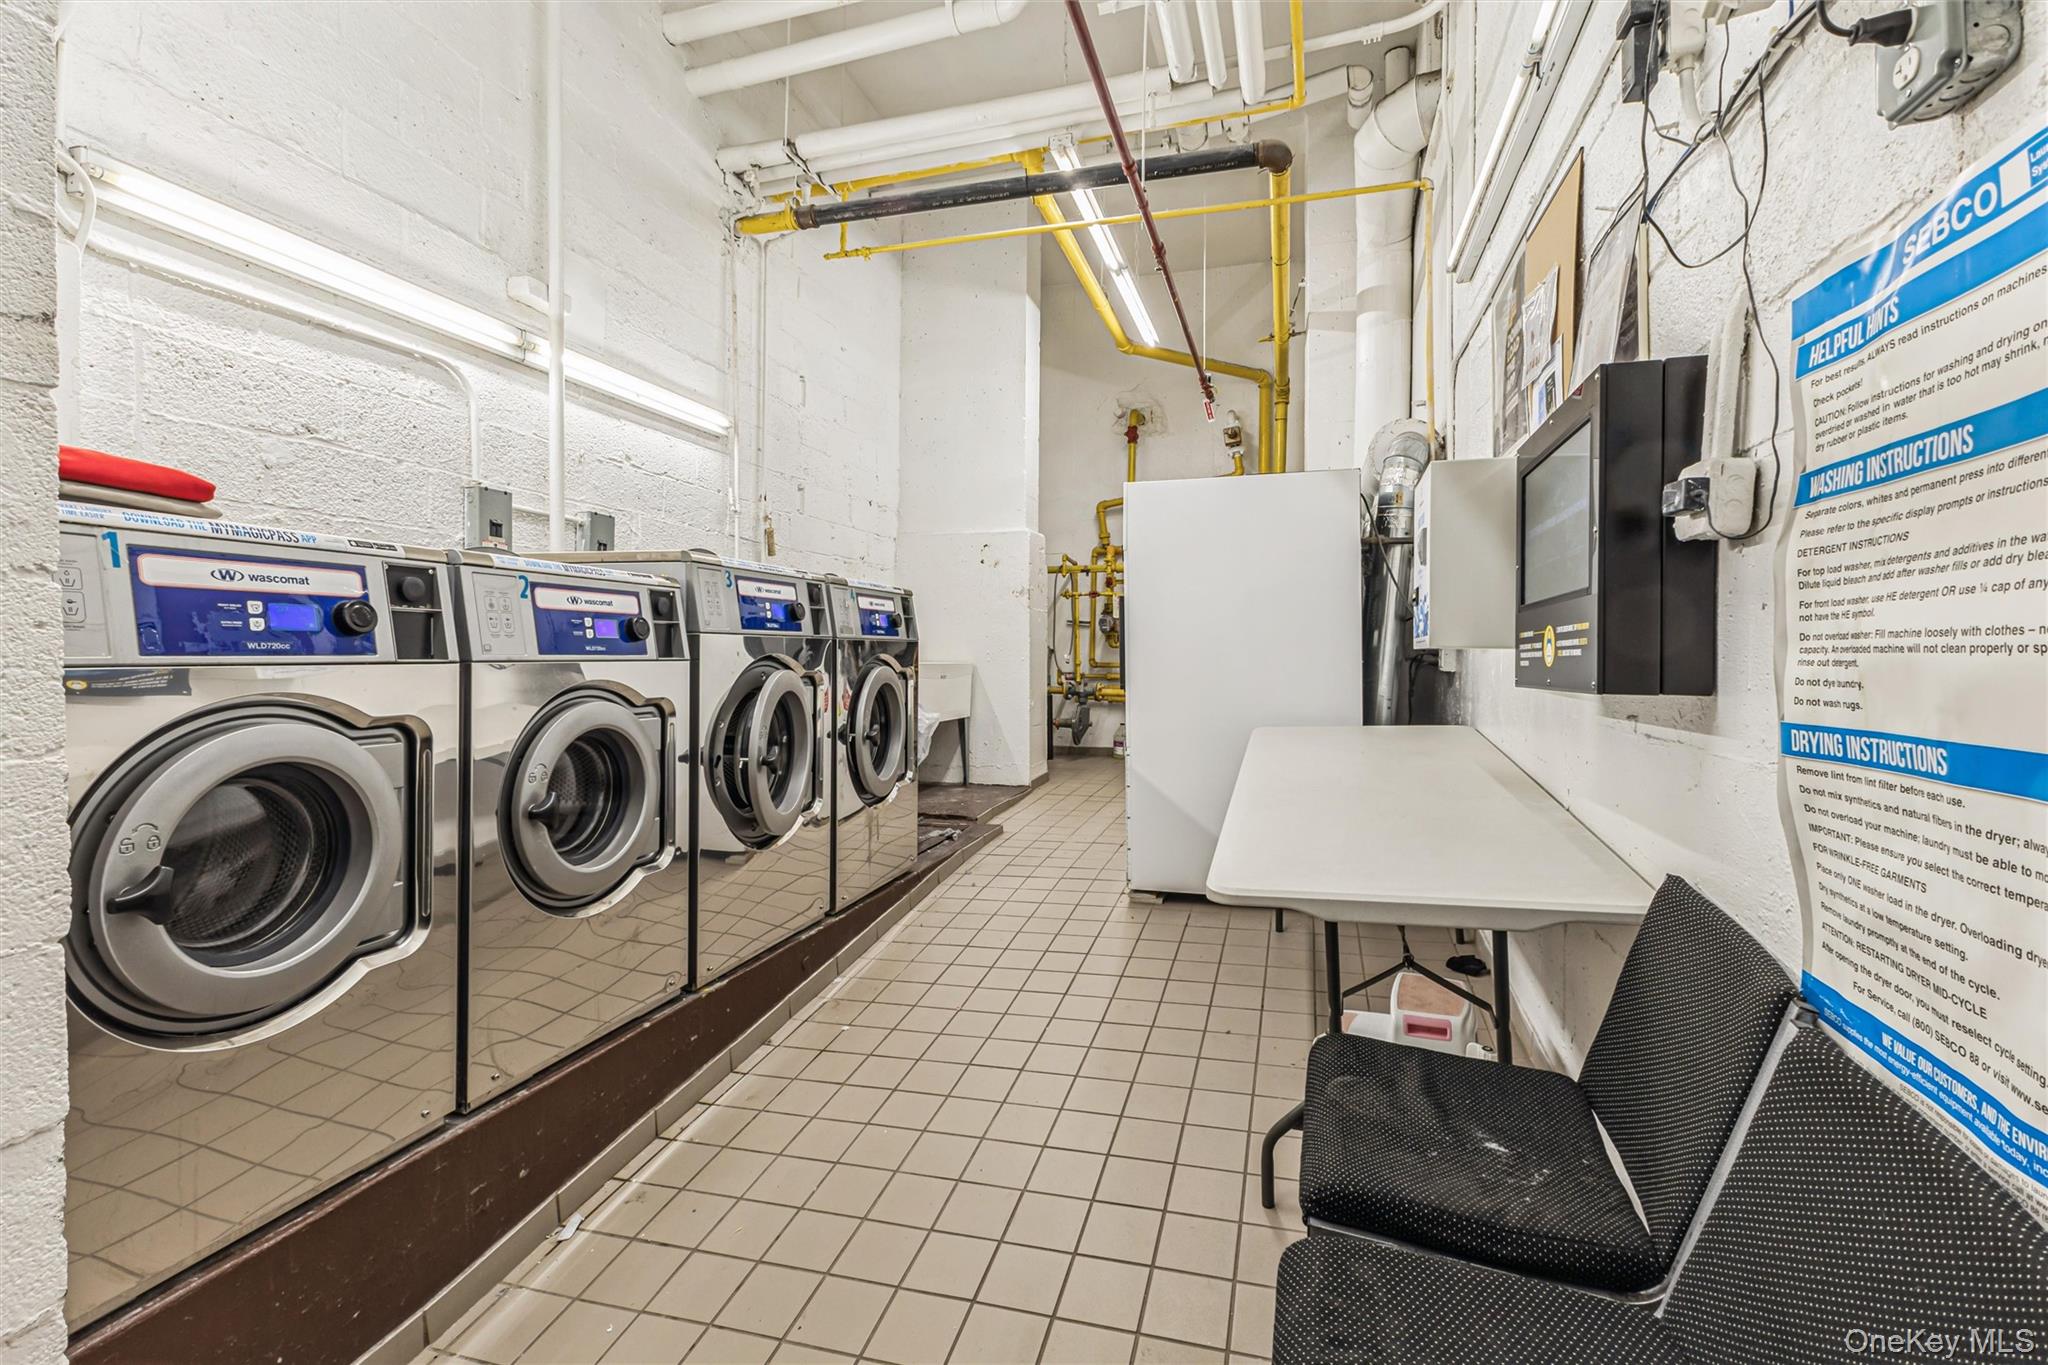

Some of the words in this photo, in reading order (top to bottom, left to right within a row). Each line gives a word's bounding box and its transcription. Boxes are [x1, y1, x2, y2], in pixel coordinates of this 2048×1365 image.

[1902, 181, 1998, 266] SEBCO
[1809, 322, 1865, 368] HELPFUL
[1866, 296, 1899, 340] HINTS
[1811, 379, 1823, 389] For
[1825, 370, 1841, 383] best
[1867, 339, 1896, 362] ALWAYS
[1897, 329, 1919, 347] read
[1921, 303, 1979, 335] instructions
[1981, 294, 1994, 307] on
[1997, 265, 2047, 297] machines
[1813, 393, 1834, 408] Check
[1836, 378, 1863, 400] pockets!
[1814, 408, 1845, 427] CAUTION:
[1848, 398, 1869, 413] Follow
[1871, 376, 1920, 403] instructions
[1923, 370, 1935, 382] for
[1937, 351, 1974, 377] washing
[1975, 341, 1993, 358] and
[1996, 329, 2030, 353] drying
[2033, 319, 2048, 333] on
[1815, 423, 1845, 440] overdried
[1846, 419, 1852, 427] or
[1854, 406, 1880, 423] washed
[1883, 402, 1890, 412] in
[1894, 393, 1917, 408] water
[1919, 384, 1935, 398] that
[1937, 379, 1944, 393] is
[1947, 373, 1962, 387] too
[1964, 367, 1980, 380] hot
[1981, 359, 2002, 376] may
[2004, 341, 2040, 363] shrink,
[1809, 472, 1864, 498] WASHING
[1866, 423, 1974, 482] INSTRUCTIONS
[1805, 506, 1837, 520] Separate
[1838, 499, 1864, 515] colors,
[1866, 494, 1893, 507] whites
[1895, 488, 1909, 500] and
[1910, 476, 1958, 498] permanent
[1959, 469, 1984, 485] press
[1987, 462, 2005, 475] into
[209, 522, 300, 544] MYMAGICPASS
[300, 533, 317, 544] APP
[1800, 524, 1825, 539] Please
[1826, 520, 1846, 535] refer
[1847, 518, 1855, 531] to
[1857, 515, 1870, 529] the
[1871, 511, 1904, 529] specific
[1905, 505, 1935, 522] display
[1937, 495, 1973, 515] prompts
[1975, 493, 1985, 503] or
[101, 530, 121, 568] 1
[1797, 542, 1847, 559] DETERGENT
[1849, 531, 1910, 553] INSTRUCTIONS
[1797, 569, 1810, 577] For
[1813, 568, 1825, 576] top
[1827, 564, 1841, 573] load
[1874, 557, 1886, 568] mix
[1886, 551, 1932, 566] detergents
[1934, 548, 1951, 559] and
[1952, 540, 1994, 556] additives
[1997, 537, 2007, 549] in
[2010, 535, 2028, 547] the
[248, 573, 310, 586] wascomat
[518, 575, 529, 599] 2
[725, 570, 732, 588] 3
[583, 599, 613, 607] wascomat
[247, 642, 291, 650] WLD720cc
[1793, 697, 1804, 706] Do
[1806, 697, 1821, 707] not
[1823, 699, 1842, 708] wash
[1843, 701, 1863, 711] rugs.
[1794, 677, 1805, 687] Do
[1806, 678, 1821, 687] not
[1822, 680, 1836, 689] dye
[1790, 728, 1843, 758] DRYING
[1845, 735, 1948, 777] INSTRUCTIONS
[1796, 765, 1829, 779] Remove
[1830, 770, 1845, 781] lint
[1846, 772, 1864, 784] from
[1864, 776, 1877, 787] lint
[1878, 778, 1898, 792] filter
[1899, 783, 1926, 798] before
[1926, 790, 1945, 802] each
[1946, 796, 1966, 809] use.
[1799, 785, 1811, 795] Do
[1813, 788, 1825, 797] not
[1828, 790, 1843, 801] mix
[1844, 794, 1882, 811] synthetics
[1883, 803, 1900, 815] and
[1902, 805, 1931, 824] natural
[1932, 813, 1953, 830] fibers
[1954, 821, 1963, 833] in
[1965, 824, 1982, 838] the
[1985, 830, 2020, 848] dryer;
[1803, 804, 1816, 814] Do
[1817, 807, 1830, 818] not
[1831, 810, 1863, 827] overload
[1864, 821, 1881, 834] your
[1883, 824, 1921, 842] machine;
[1922, 834, 1950, 855] laundry
[1952, 847, 1973, 858] must
[1976, 853, 1989, 865] be
[1993, 858, 2018, 873] able
[2021, 865, 2032, 878] to
[1813, 842, 1829, 855] FOR
[1880, 868, 1927, 893] GARMENTS
[1856, 942, 1905, 974] RESTARTING
[1906, 967, 1931, 990] DRYER
[1933, 983, 1988, 1020] MID-CYCLE
[1853, 981, 1866, 994] For
[1867, 989, 1896, 1014] Service,
[1897, 1009, 1911, 1025] call
[1911, 1017, 1934, 1039] (800)
[1934, 1030, 1967, 1058] SEBCO
[1969, 1051, 1980, 1066] 88
[1981, 1062, 1992, 1075] or
[1993, 1070, 2010, 1089] visit
[1860, 965, 1872, 977] the
[1874, 973, 1892, 989] dryer
[1894, 985, 1914, 1002] door,
[1916, 994, 1930, 1012] you
[1931, 1007, 1950, 1025] must
[1951, 1019, 1993, 1048] reselect
[1994, 1043, 2016, 1065] cycle
[2016, 1058, 2048, 1088] setting.
[1981, 1101, 1998, 1125] AND
[1997, 1114, 2010, 1139] THE
